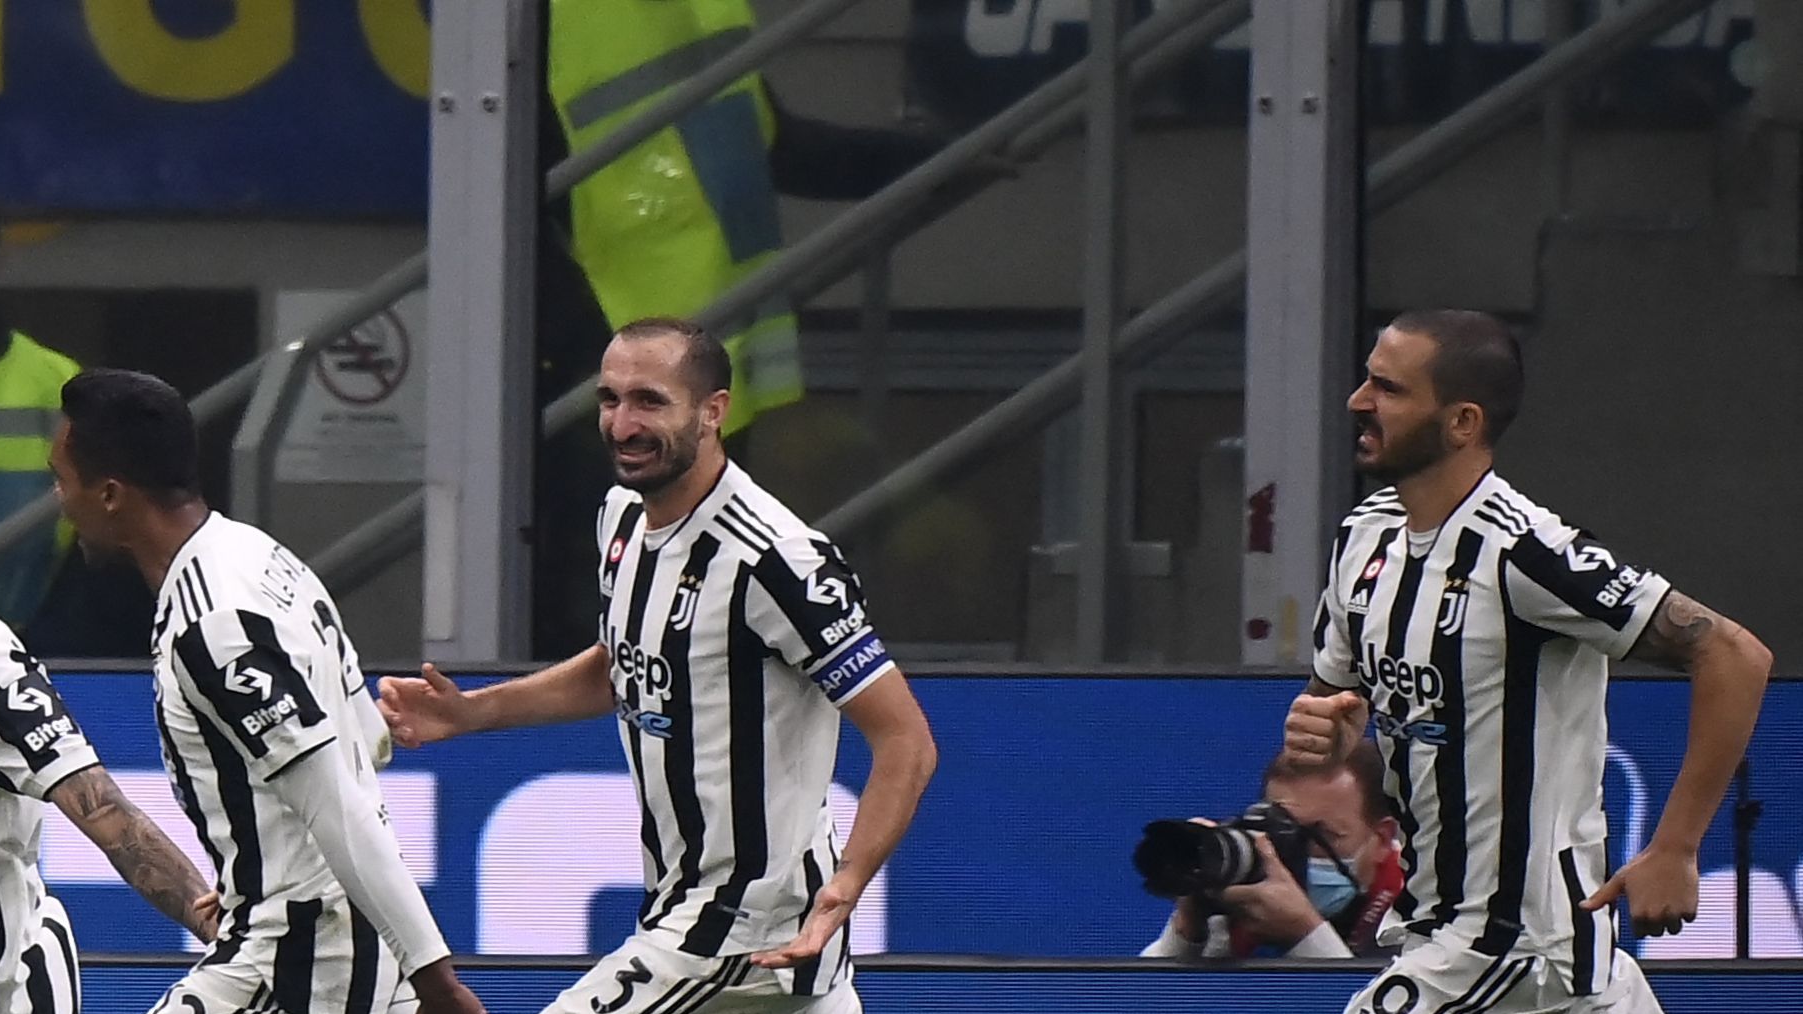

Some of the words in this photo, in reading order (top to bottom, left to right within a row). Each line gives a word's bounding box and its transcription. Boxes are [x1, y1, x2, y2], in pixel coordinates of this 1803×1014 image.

[1595, 565, 1641, 608] Bitg
[820, 601, 865, 646] Bitg
[819, 638, 886, 692] APITAN
[1358, 641, 1445, 708] Jeep
[241, 694, 298, 736] Bitget
[590, 956, 654, 1014] 3
